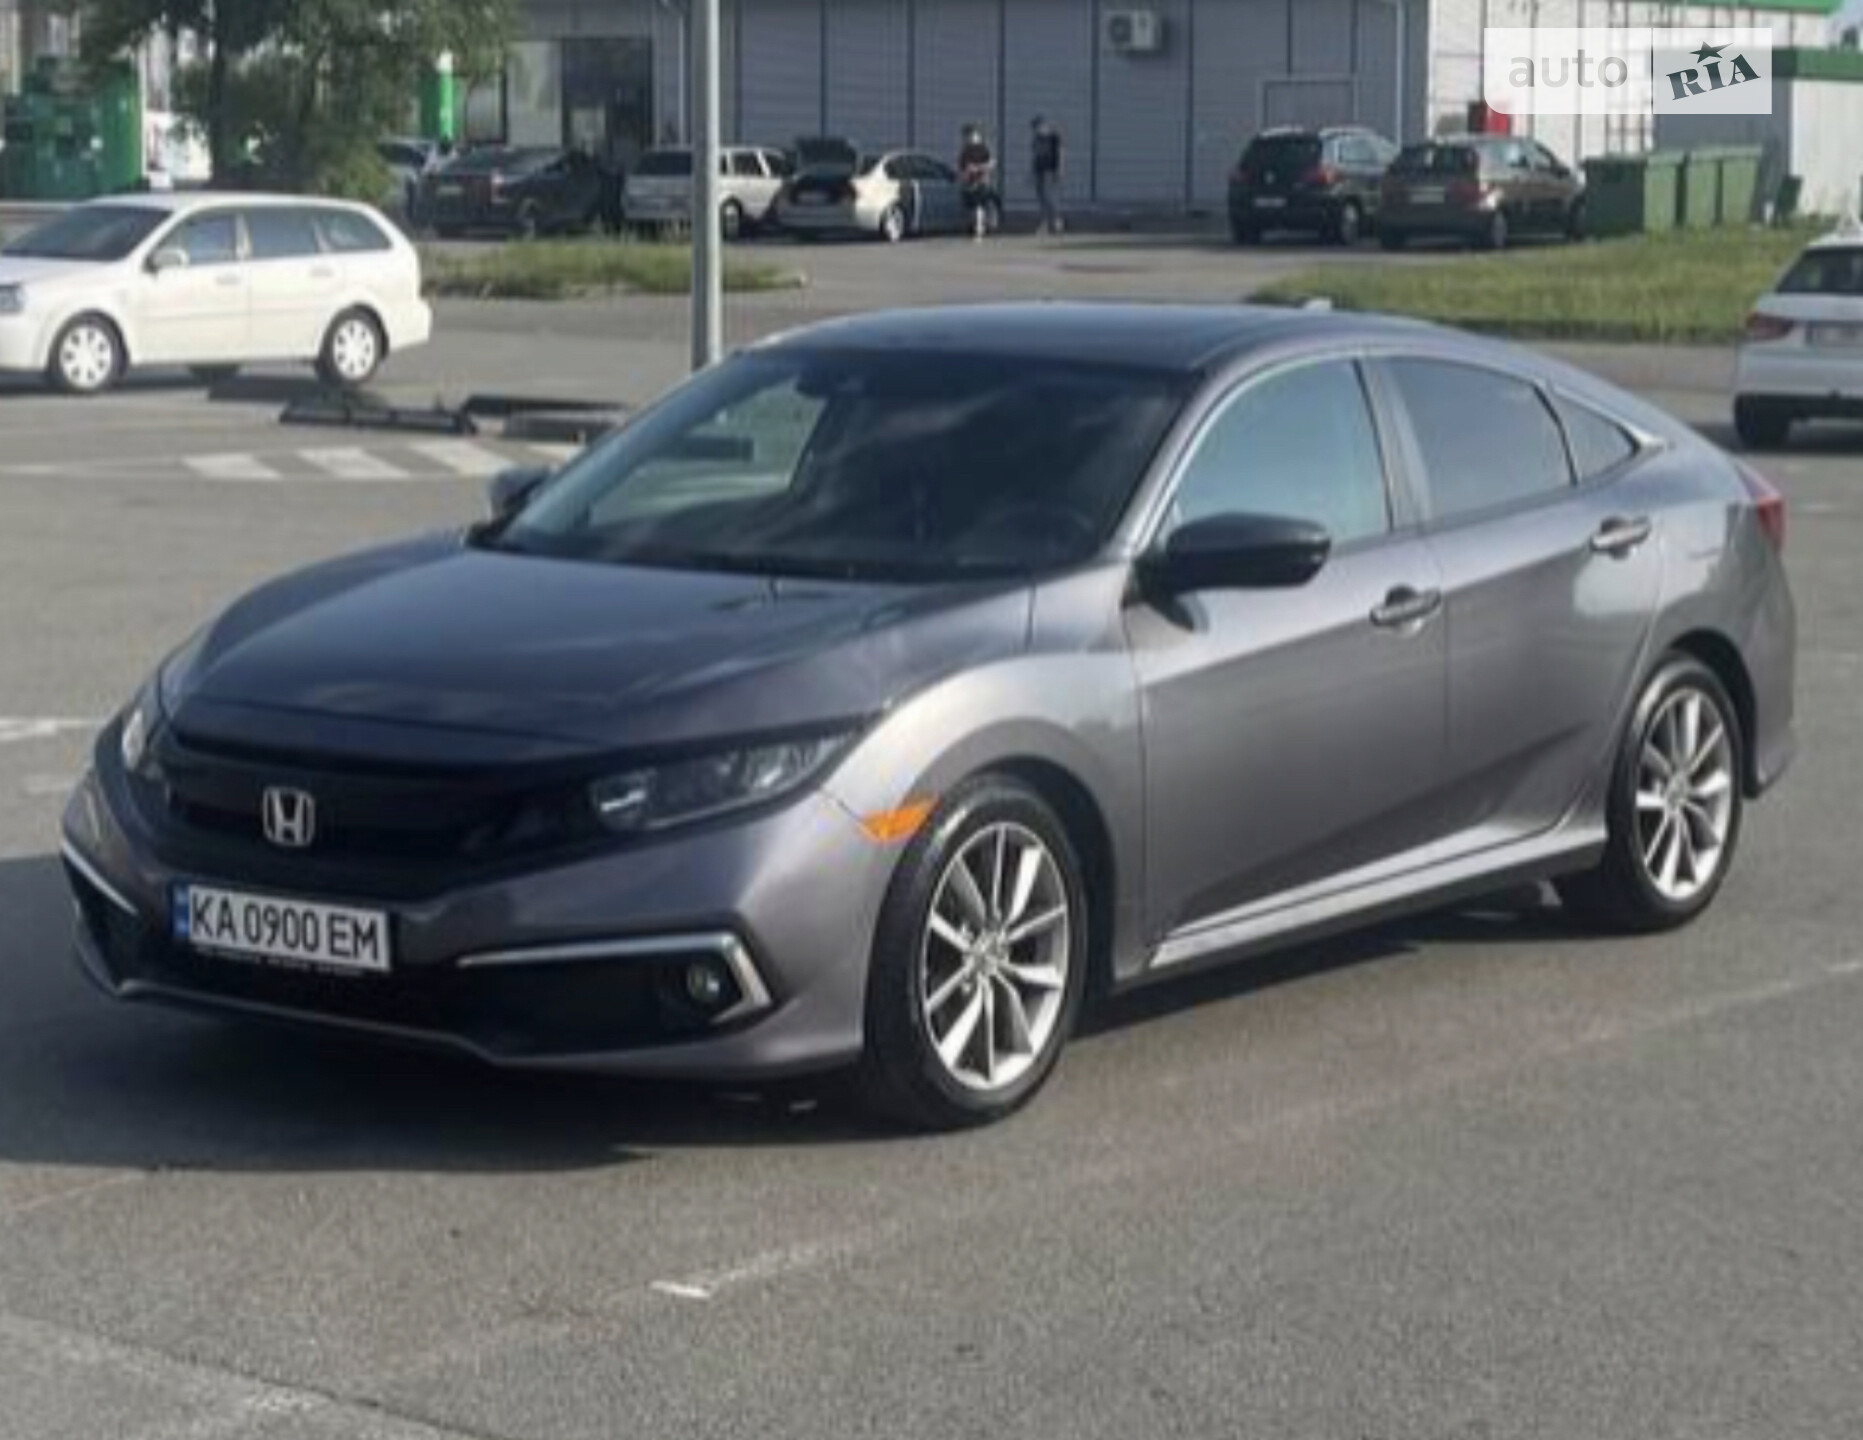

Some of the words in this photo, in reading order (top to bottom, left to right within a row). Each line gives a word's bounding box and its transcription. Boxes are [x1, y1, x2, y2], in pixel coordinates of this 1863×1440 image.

[191, 894, 237, 942] KA
[243, 903, 320, 952] 0900
[327, 911, 379, 961] EM
